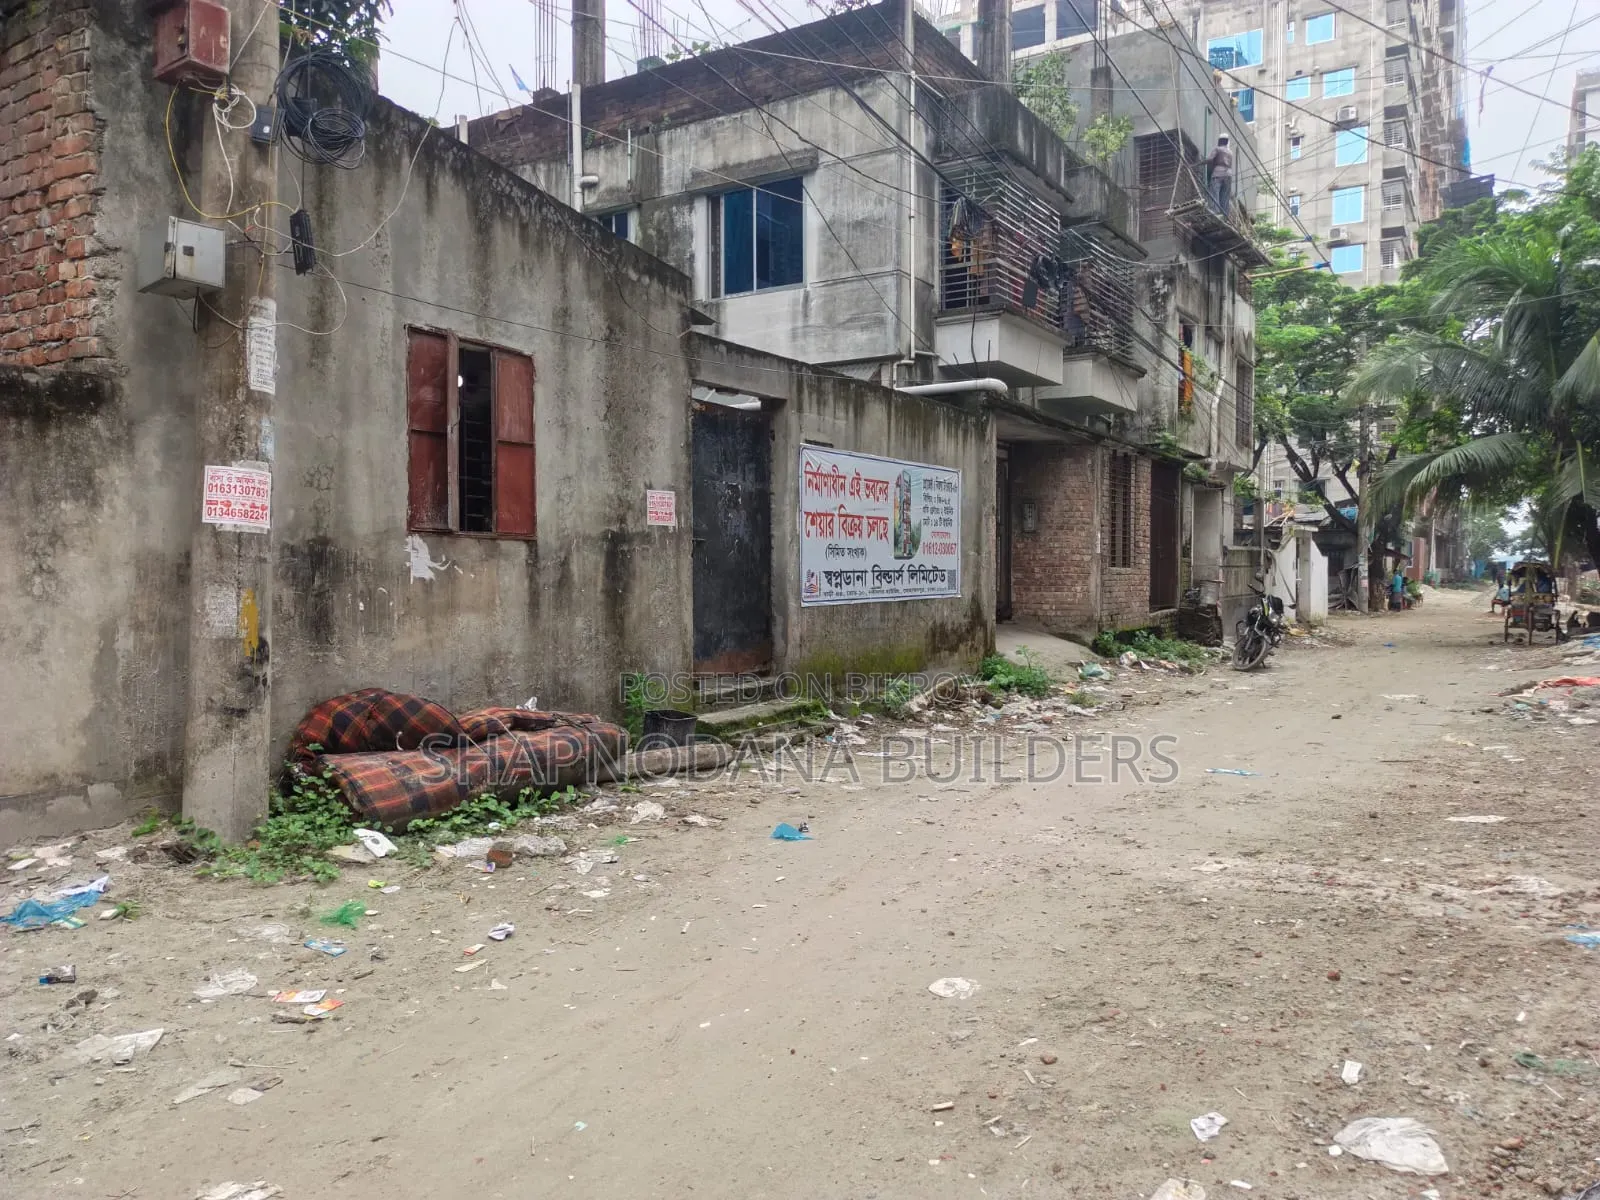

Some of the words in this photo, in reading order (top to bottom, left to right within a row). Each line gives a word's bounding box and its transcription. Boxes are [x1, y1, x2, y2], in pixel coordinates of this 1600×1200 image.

[208, 483, 268, 498] 01631307831
[804, 461, 847, 499] নির্মাণাধীন
[849, 468, 862, 500] এই
[864, 478, 889, 506] ভবনের
[207, 506, 268, 520] 01346582241
[804, 510, 835, 541] শেয়ার
[866, 515, 889, 545] চলছে
[823, 567, 868, 591] স্বপ্নডানা
[872, 563, 906, 589] বিল্ডার্স
[907, 564, 946, 585] লিমিটেড
